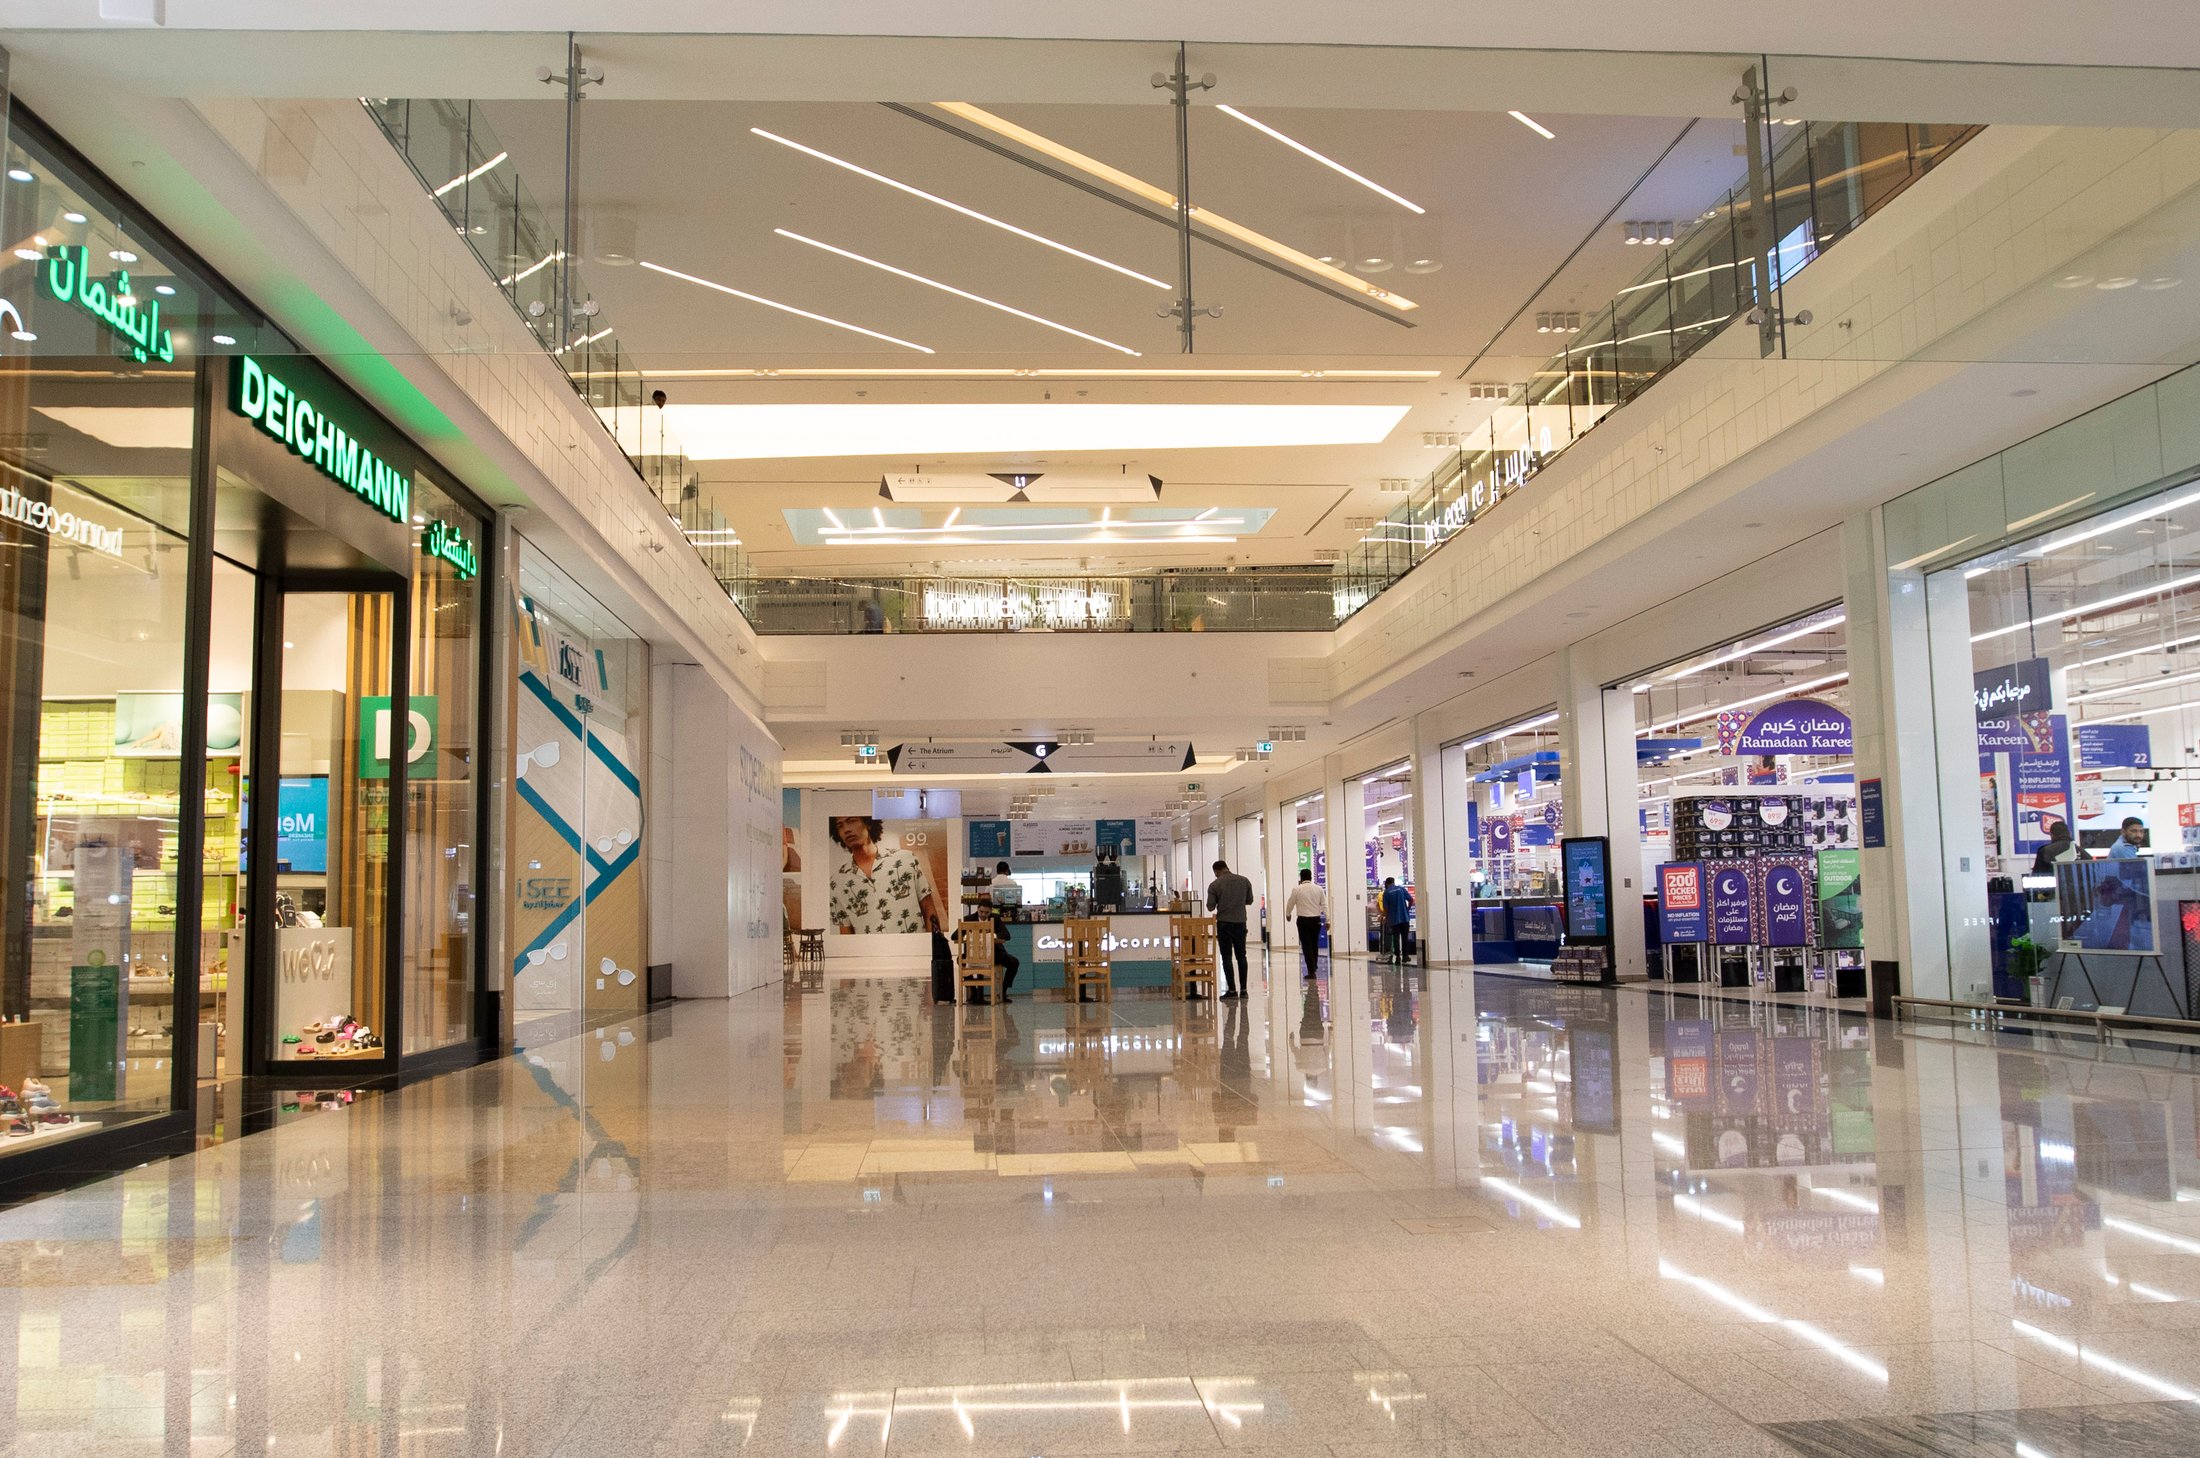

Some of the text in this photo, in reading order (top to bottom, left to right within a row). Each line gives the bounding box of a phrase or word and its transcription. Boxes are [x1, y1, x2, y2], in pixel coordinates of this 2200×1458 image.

[50, 245, 174, 363] دايشمان
[241, 354, 409, 524] DEICHMANN
[1015, 476, 1026, 487] L1
[430, 519, 477, 581] دايشمان
[1760, 718, 1845, 736] رمضان كريم
[375, 710, 432, 764] D
[1742, 735, 1852, 748] Ramadan Karee
[1035, 744, 1046, 757] G
[2134, 753, 2148, 763] 22
[905, 832, 927, 847] 99
[1668, 875, 1693, 887] 200
[1666, 887, 1697, 895] LOCKED
[1716, 898, 1747, 908] توفير أكثر
[1773, 902, 1799, 912] رمضان
[1776, 912, 1797, 922] كريم
